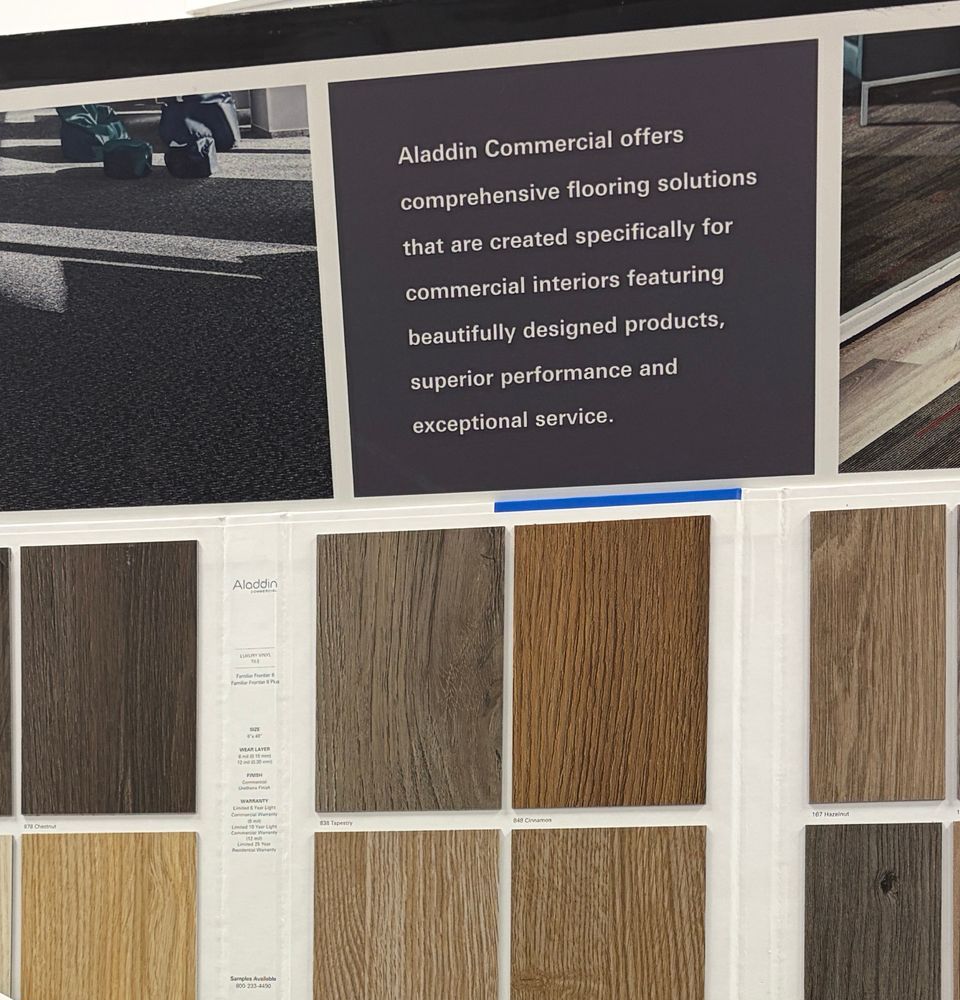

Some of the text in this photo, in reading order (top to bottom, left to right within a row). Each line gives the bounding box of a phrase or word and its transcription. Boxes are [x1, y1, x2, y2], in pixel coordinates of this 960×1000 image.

[398, 127, 684, 165] Aladdin Commercial offers
[400, 170, 757, 212] comprehensive flooring solutions
[403, 217, 733, 256] that are created specifically for
[406, 266, 725, 301] commercial interiors featuring
[408, 312, 725, 346] beautifully designed products,
[410, 358, 678, 392] superior performance and
[412, 409, 614, 435] exceptional service.
[233, 579, 278, 590] Aladdin
